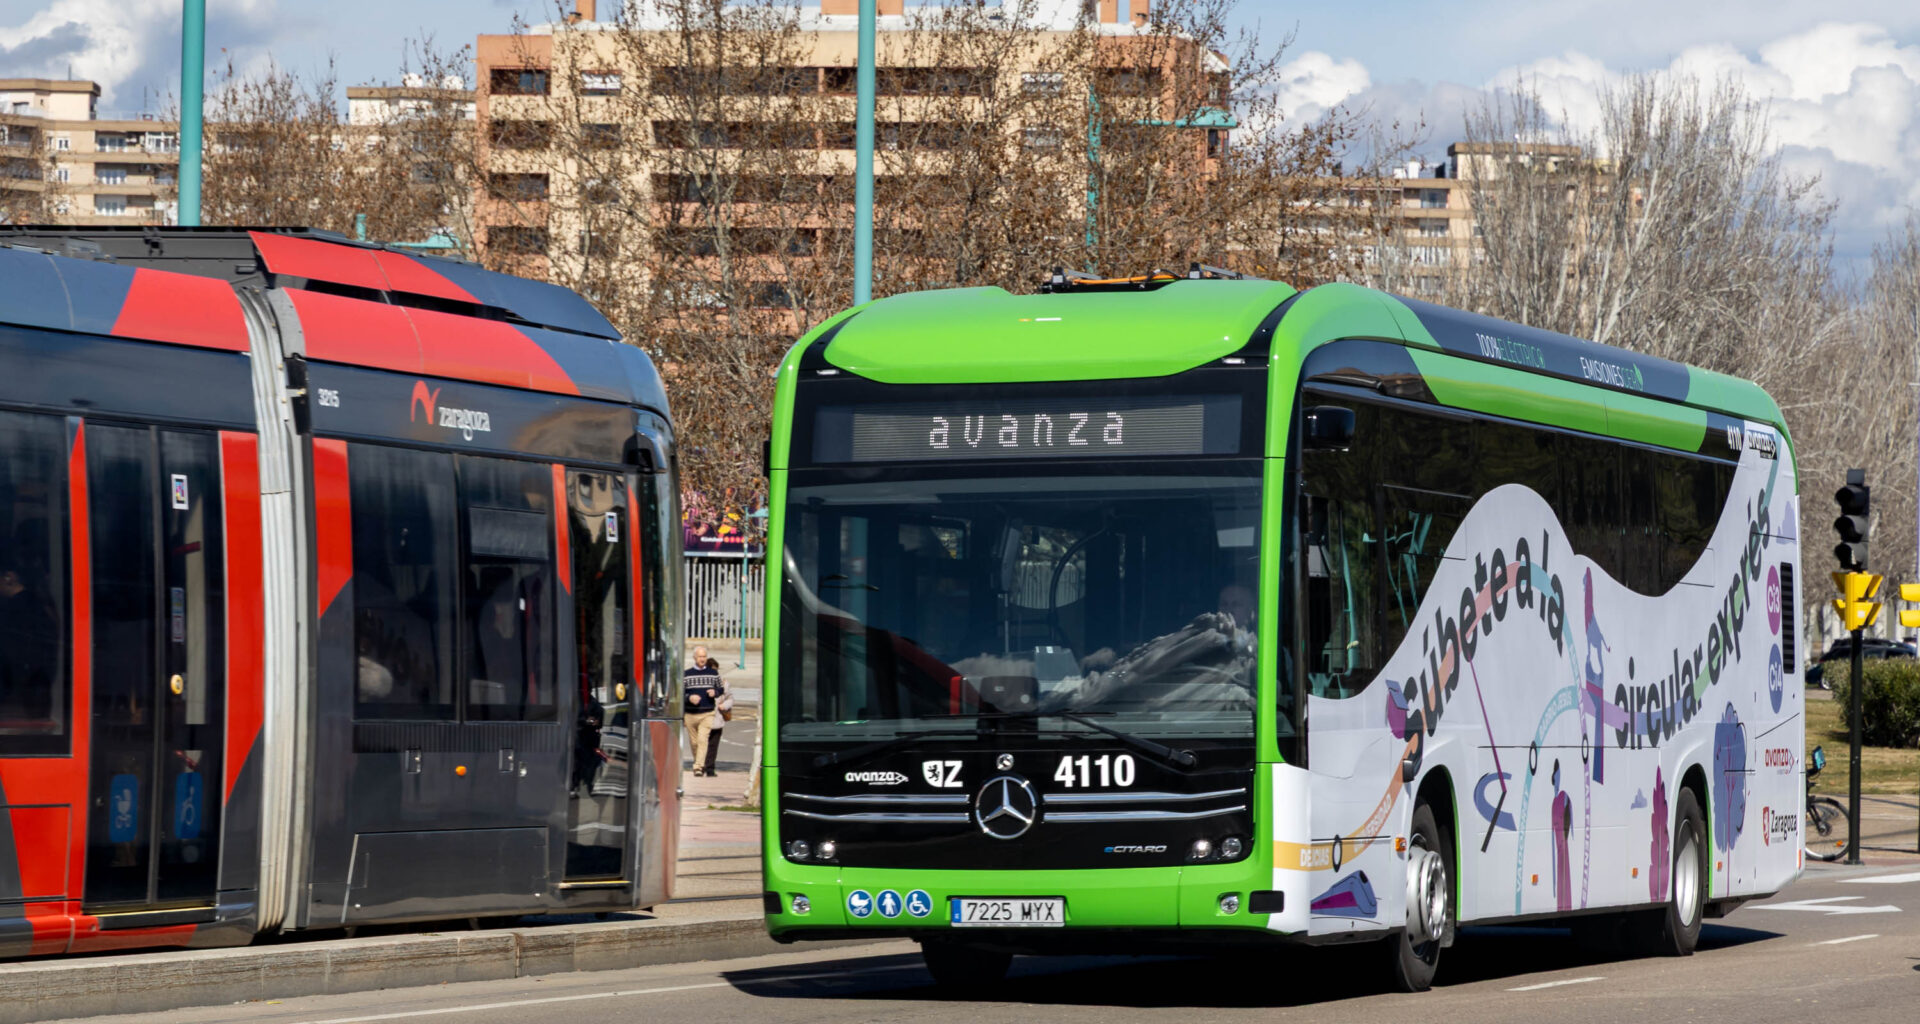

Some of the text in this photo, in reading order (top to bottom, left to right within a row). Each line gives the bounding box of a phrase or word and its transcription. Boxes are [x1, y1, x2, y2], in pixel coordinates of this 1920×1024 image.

[317, 388, 340, 407] 3215
[438, 406, 491, 441] zaragoza
[929, 412, 1124, 449] avanza
[1727, 424, 1742, 451] 4110
[1767, 584, 1780, 613] Ci3
[1404, 548, 1508, 776] súbete
[1516, 537, 1533, 609] a
[1540, 528, 1565, 658] la
[1615, 643, 1703, 750] circular
[1708, 488, 1770, 685] exprés
[1769, 662, 1782, 691] Ci4
[1054, 754, 1135, 788] 4110
[1765, 748, 1789, 767] avanza
[845, 771, 895, 782] avanza
[1771, 810, 1797, 841] Zaragoza
[1104, 845, 1167, 853] eCITARO
[967, 902, 1055, 920] 7225 MYX
